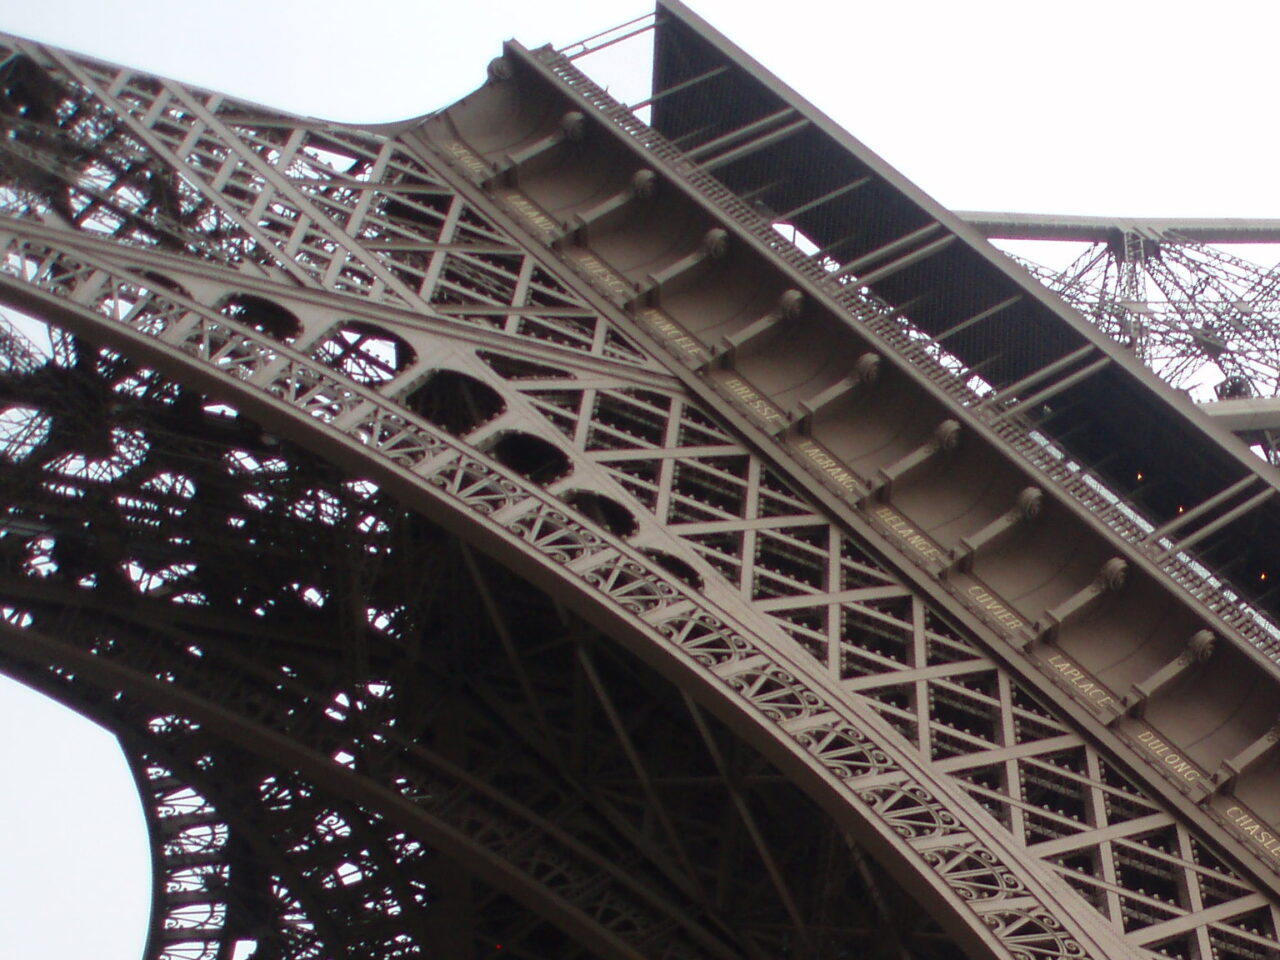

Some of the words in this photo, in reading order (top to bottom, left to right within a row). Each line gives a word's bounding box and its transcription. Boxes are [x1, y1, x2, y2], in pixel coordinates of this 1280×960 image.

[505, 193, 556, 234] LALAND
[579, 254, 627, 294] TRESC
[797, 439, 860, 492] LAGRANG
[875, 506, 941, 562] BELANGE
[965, 584, 1024, 632] CUVIER
[1045, 652, 1115, 709] LAPLACE
[1135, 729, 1201, 783] DULONG
